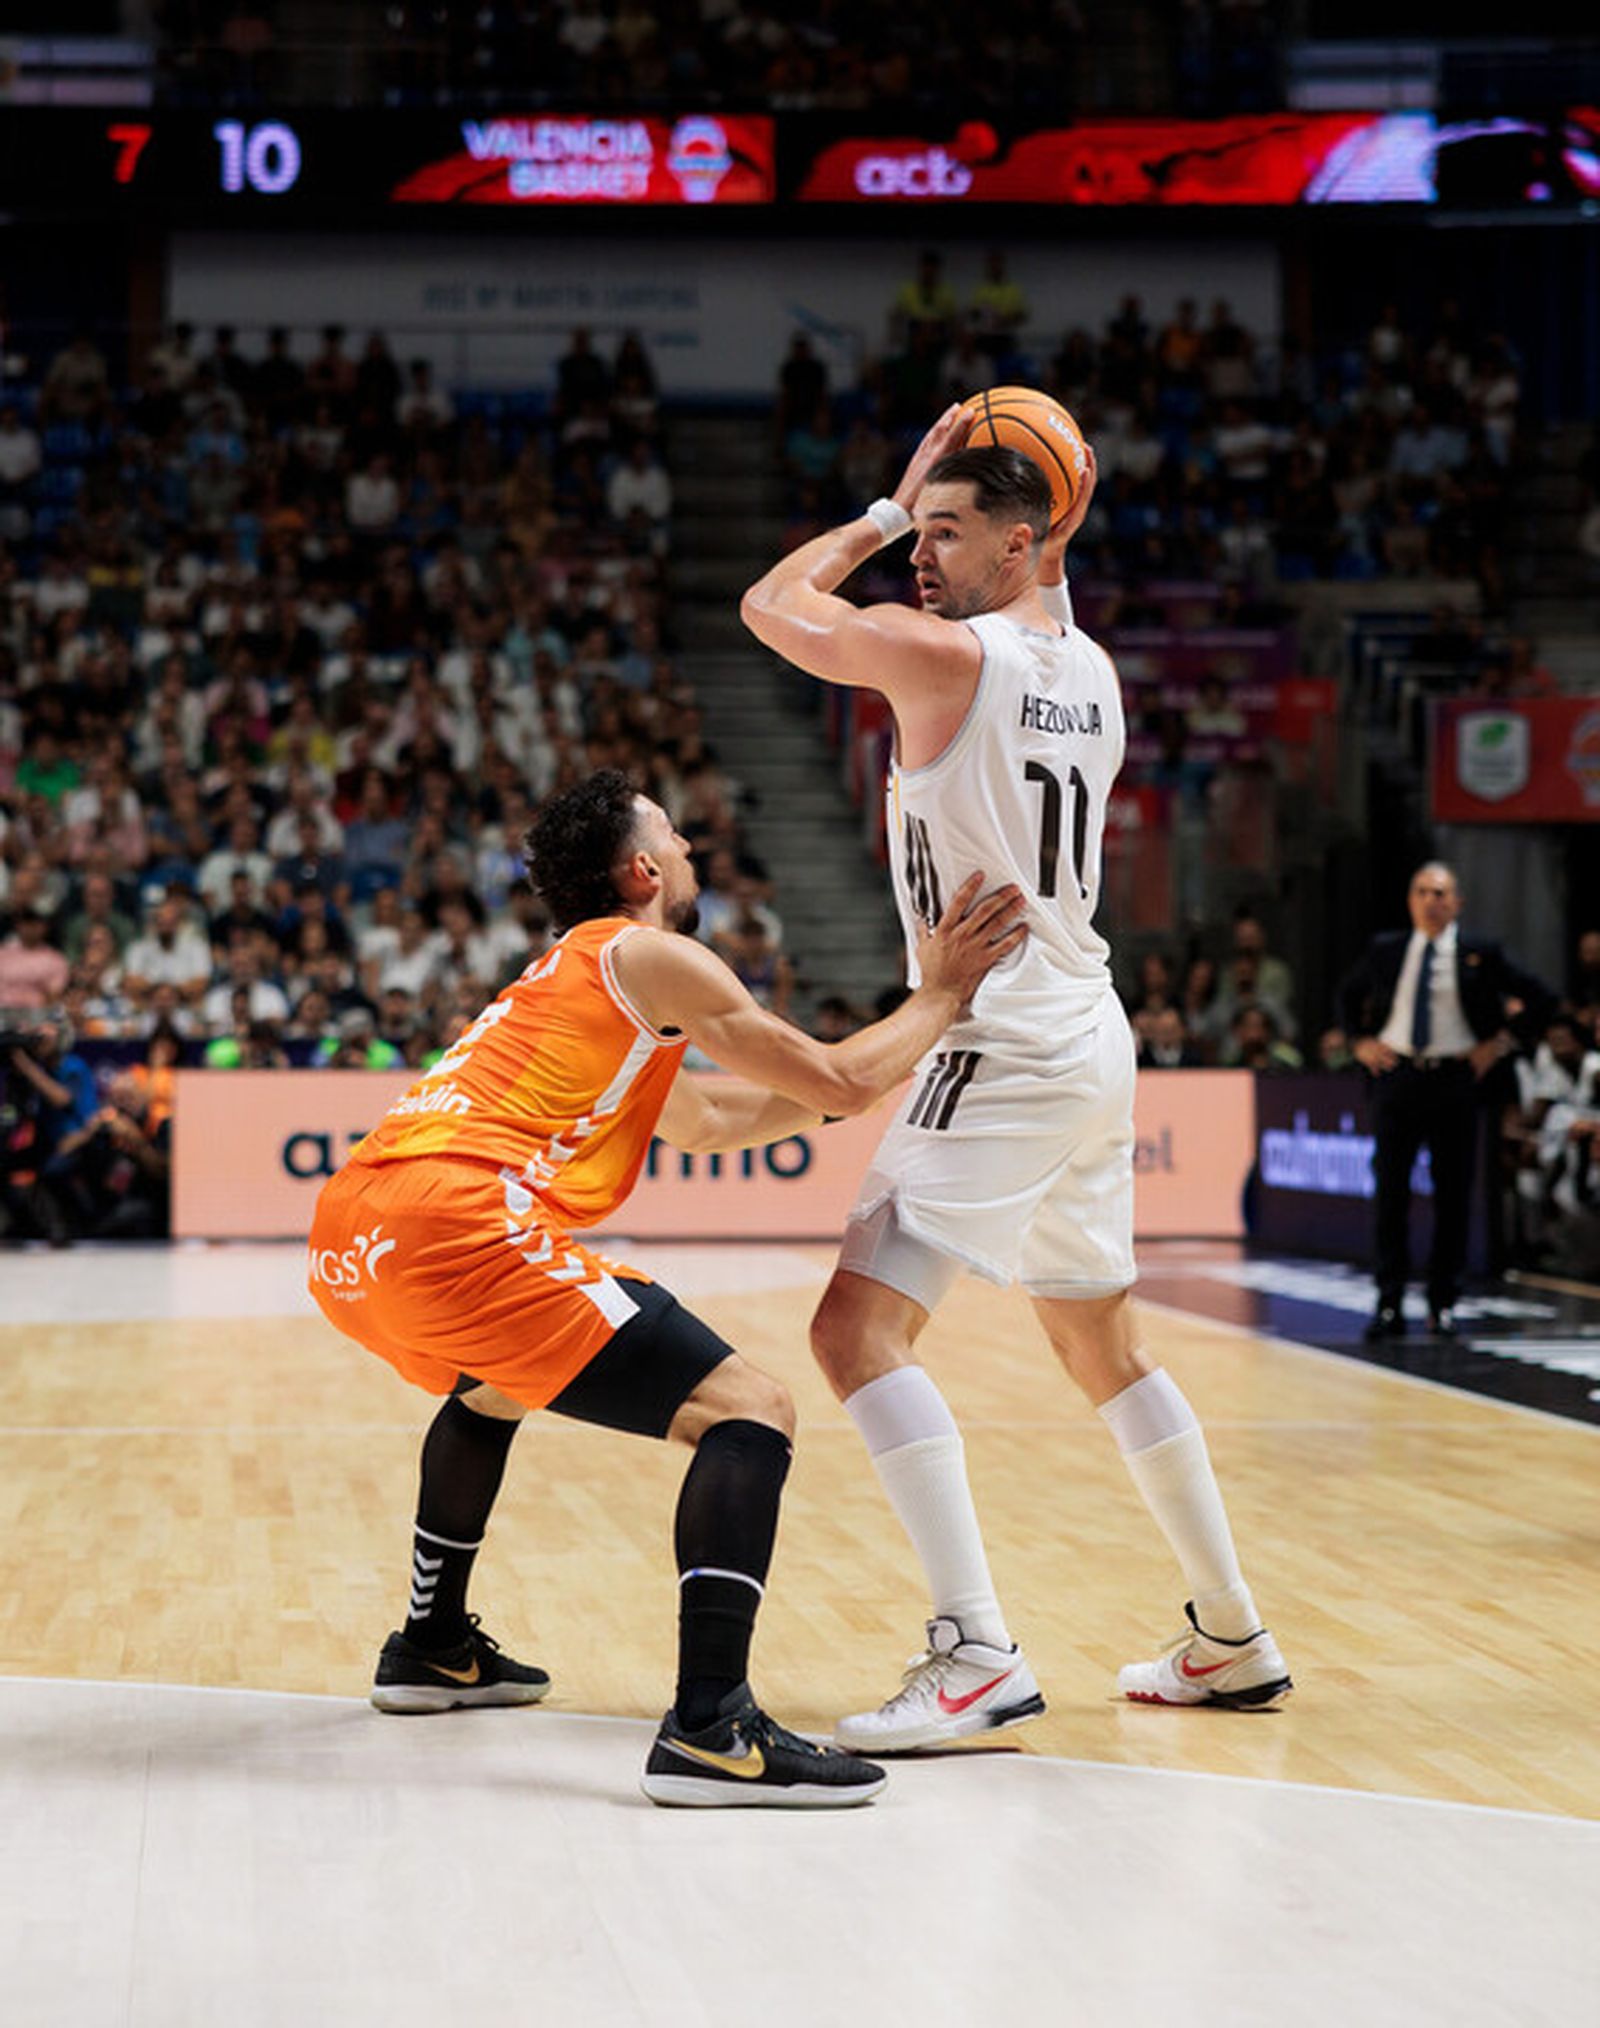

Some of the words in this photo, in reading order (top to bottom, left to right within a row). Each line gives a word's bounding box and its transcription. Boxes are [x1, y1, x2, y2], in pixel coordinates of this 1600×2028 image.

[107, 123, 152, 184] 7
[213, 118, 301, 193] 10
[461, 119, 653, 161] VALENCIA
[855, 145, 973, 197] acb
